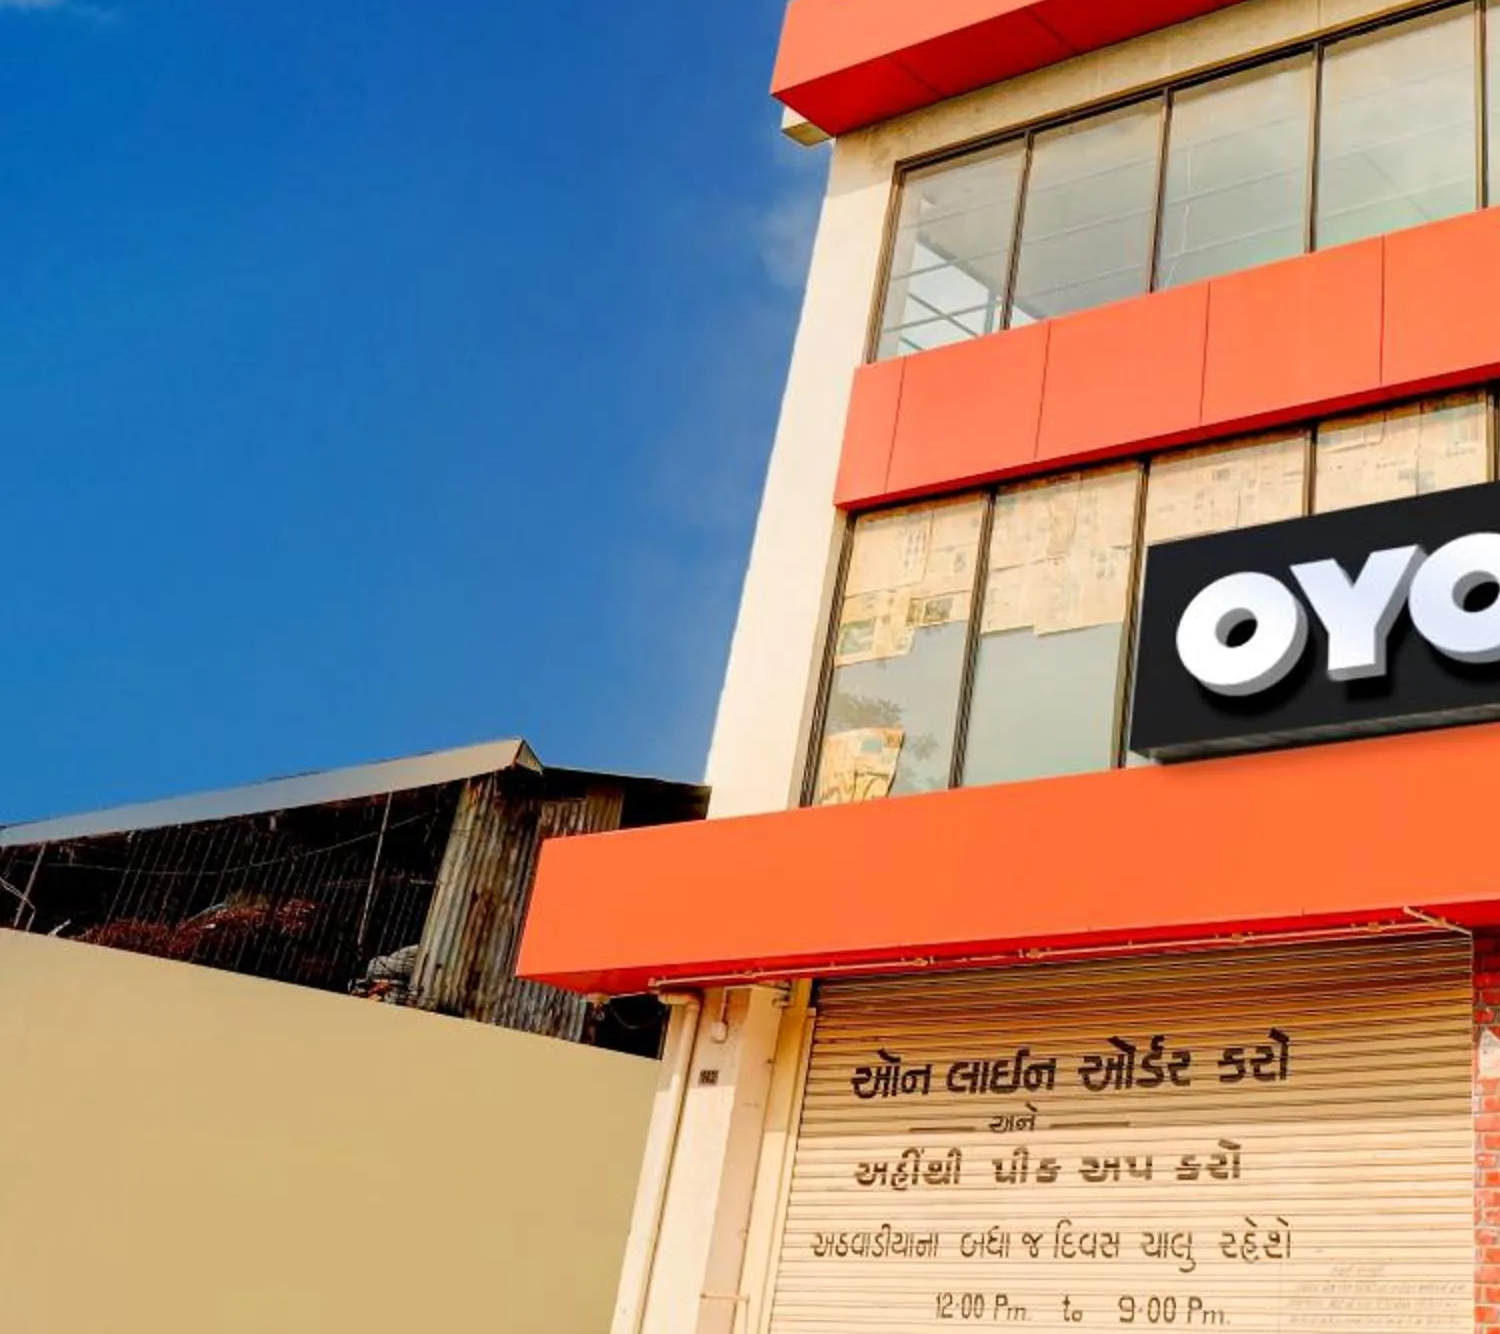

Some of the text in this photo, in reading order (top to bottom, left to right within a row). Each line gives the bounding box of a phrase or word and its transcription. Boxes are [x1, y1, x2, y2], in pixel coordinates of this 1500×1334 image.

[1217, 1027, 1290, 1083] કરો
[988, 1101, 1038, 1133] અને
[991, 1147, 1062, 1184] પીક
[1078, 1155, 1152, 1183] અપ
[1175, 1138, 1241, 1180] કરો
[1054, 1219, 1120, 1259] દિવસ
[1141, 1232, 1197, 1273] ચાલુ
[1063, 1295, 1083, 1322] to
